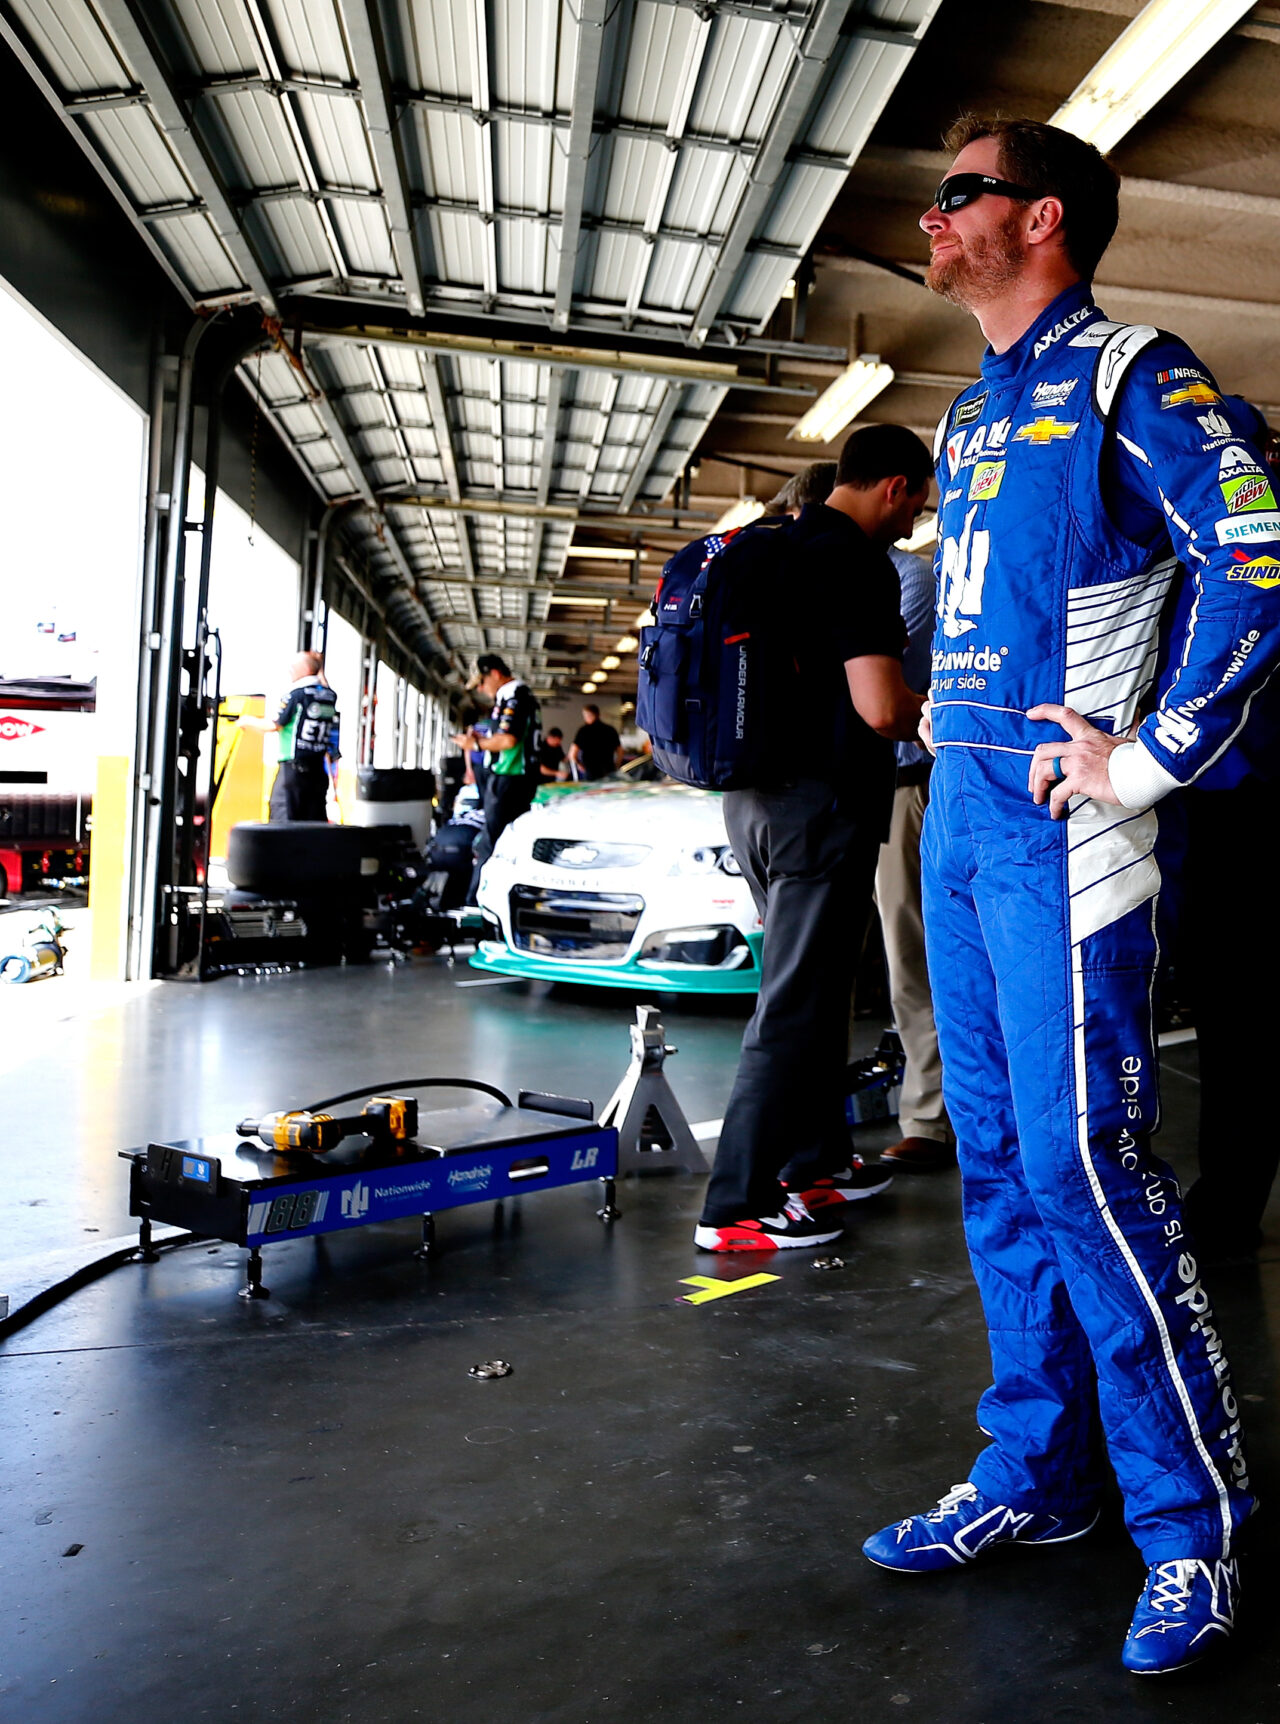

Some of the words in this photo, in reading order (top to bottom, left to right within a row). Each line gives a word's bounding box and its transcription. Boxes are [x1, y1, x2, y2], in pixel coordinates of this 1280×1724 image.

[1033, 306, 1092, 360] AXALTA
[1218, 465, 1265, 481] AXALTA
[738, 645, 747, 686] UNDER
[956, 673, 987, 691] side
[1177, 629, 1261, 719] Nanwide
[735, 687, 746, 739] ARMOUR
[1118, 1055, 1142, 1120] side
[570, 1147, 600, 1171] LR
[374, 1179, 432, 1199] Nationwide
[1145, 1180, 1166, 1215] on
[265, 1189, 320, 1234] 88
[1164, 1219, 1185, 1248] is
